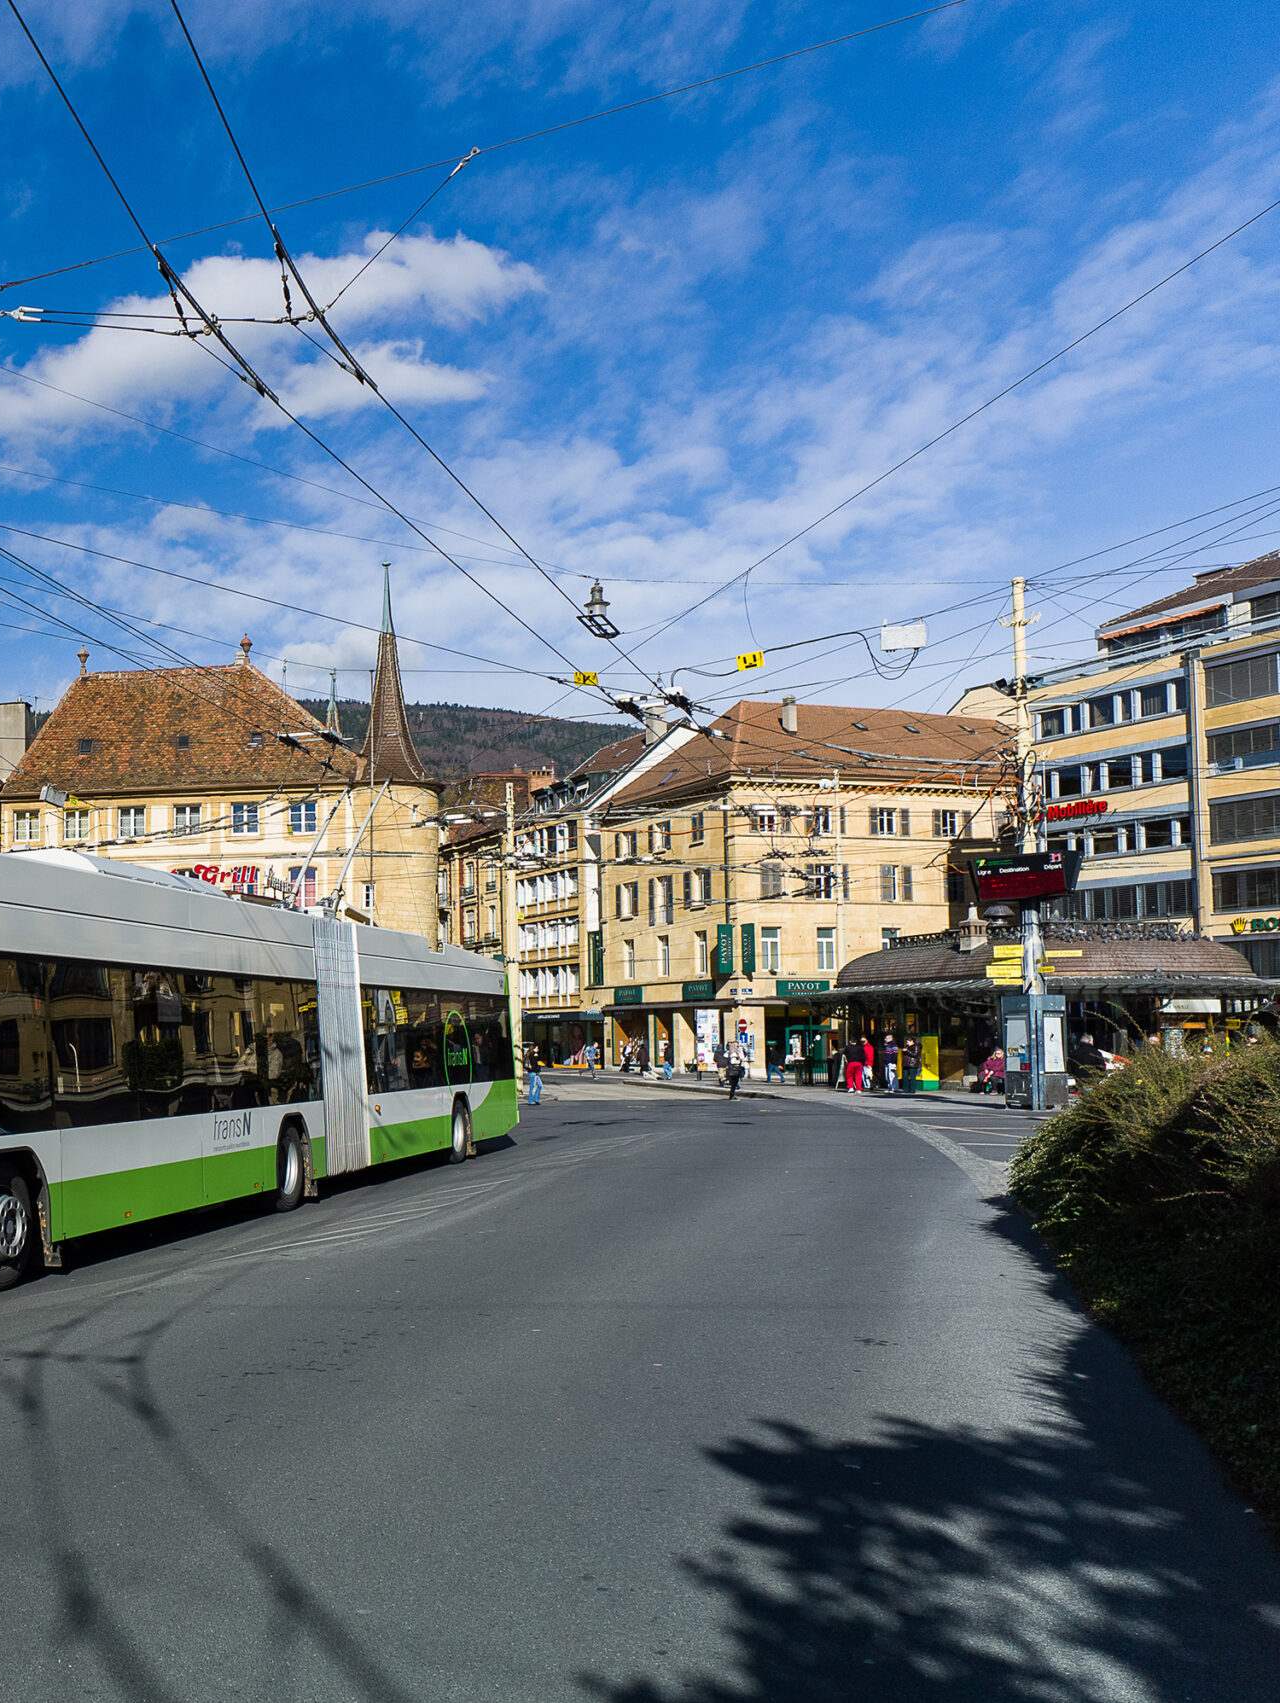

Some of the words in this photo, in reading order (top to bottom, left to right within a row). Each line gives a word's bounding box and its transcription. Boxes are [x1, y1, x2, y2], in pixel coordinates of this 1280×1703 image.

[1048, 799, 1108, 819] Mobilière
[194, 864, 256, 885] Grill
[999, 866, 1030, 874] Destination
[788, 982, 821, 990] PAYOT
[213, 1111, 252, 1140] transN
